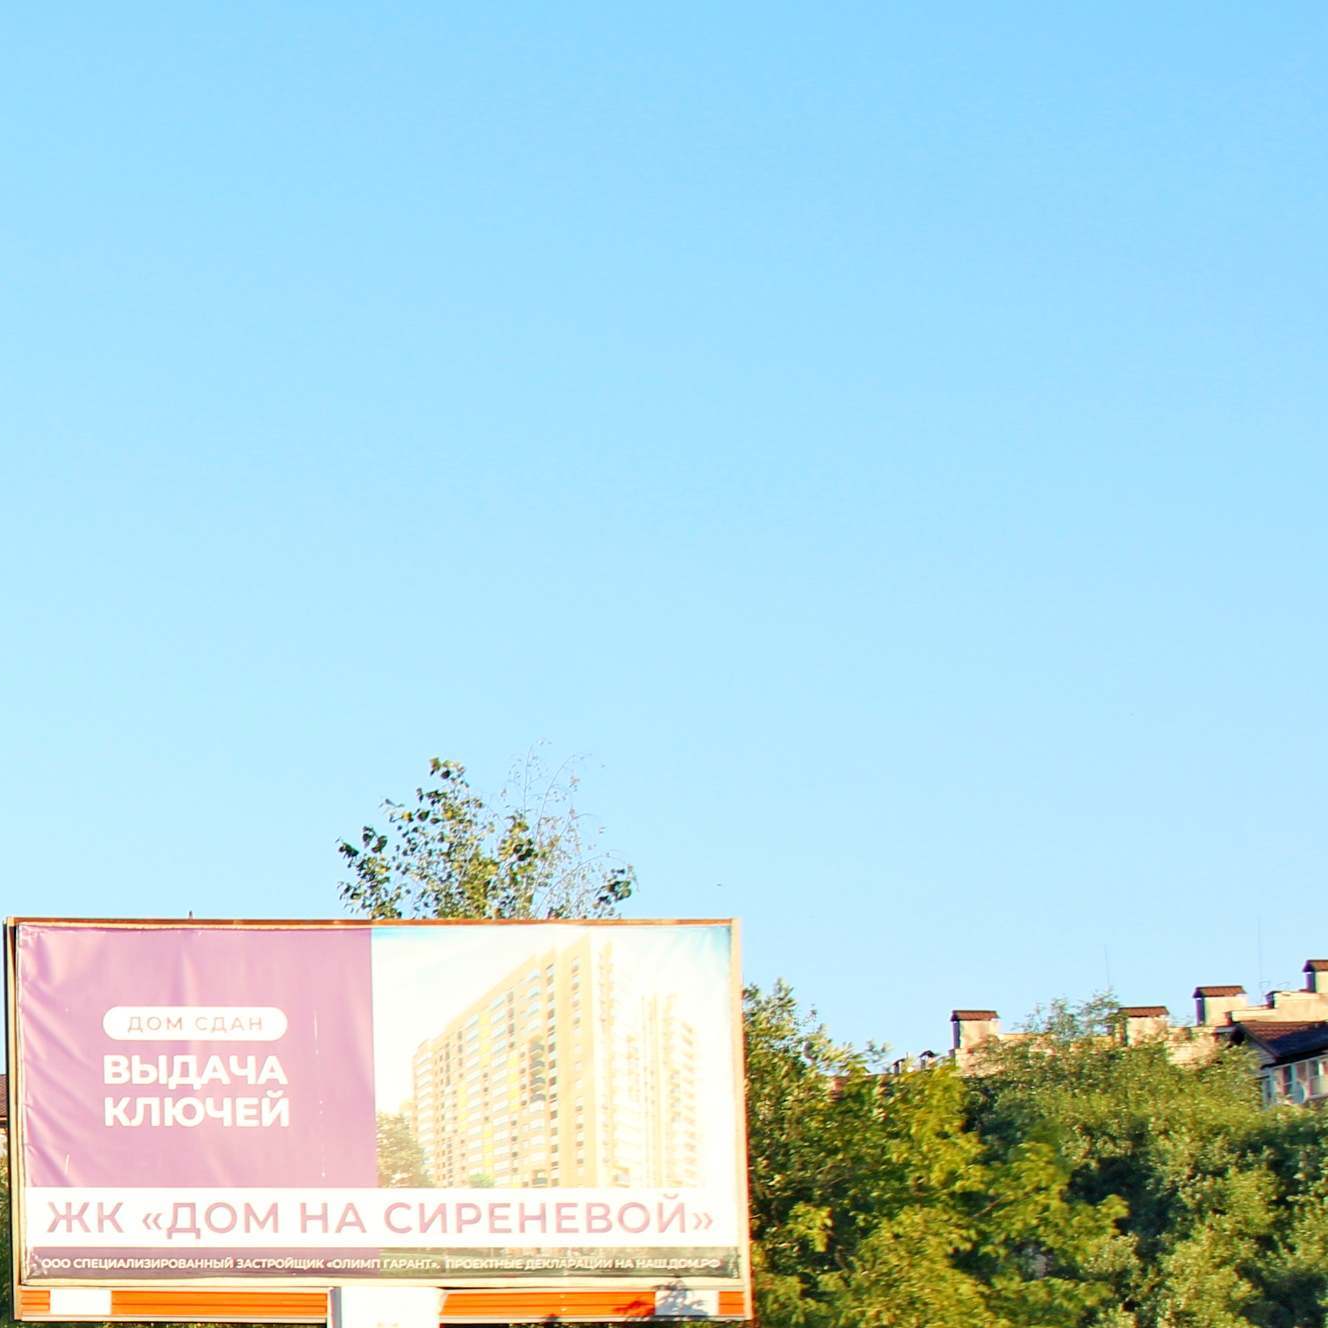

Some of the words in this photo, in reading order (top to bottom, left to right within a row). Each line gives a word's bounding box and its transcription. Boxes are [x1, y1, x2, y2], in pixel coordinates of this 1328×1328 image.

[128, 1016, 183, 1033] ДОМ
[195, 1016, 262, 1033] СДАН
[103, 1055, 288, 1090] ВЫДАЧА
[104, 1090, 290, 1127] КЛЮЧЕЙ
[47, 1201, 124, 1234] ЖК
[142, 1201, 278, 1240] «ДОМ
[299, 1201, 367, 1234] НА
[383, 1193, 714, 1234] СИРЕНЕВОЙ»
[41, 1258, 71, 1269] ООО
[73, 1256, 234, 1270] СПЕЦИАЛИЗИРОВАННЫЙ
[236, 1256, 325, 1271] ЗАСТРОЙЩИК
[326, 1257, 381, 1270] «ОЛИМП
[445, 1257, 523, 1270] ПРОЕКТНЫЕ
[524, 1256, 613, 1271] ДЕКЛАРАЦИИ
[615, 1257, 634, 1269] НА
